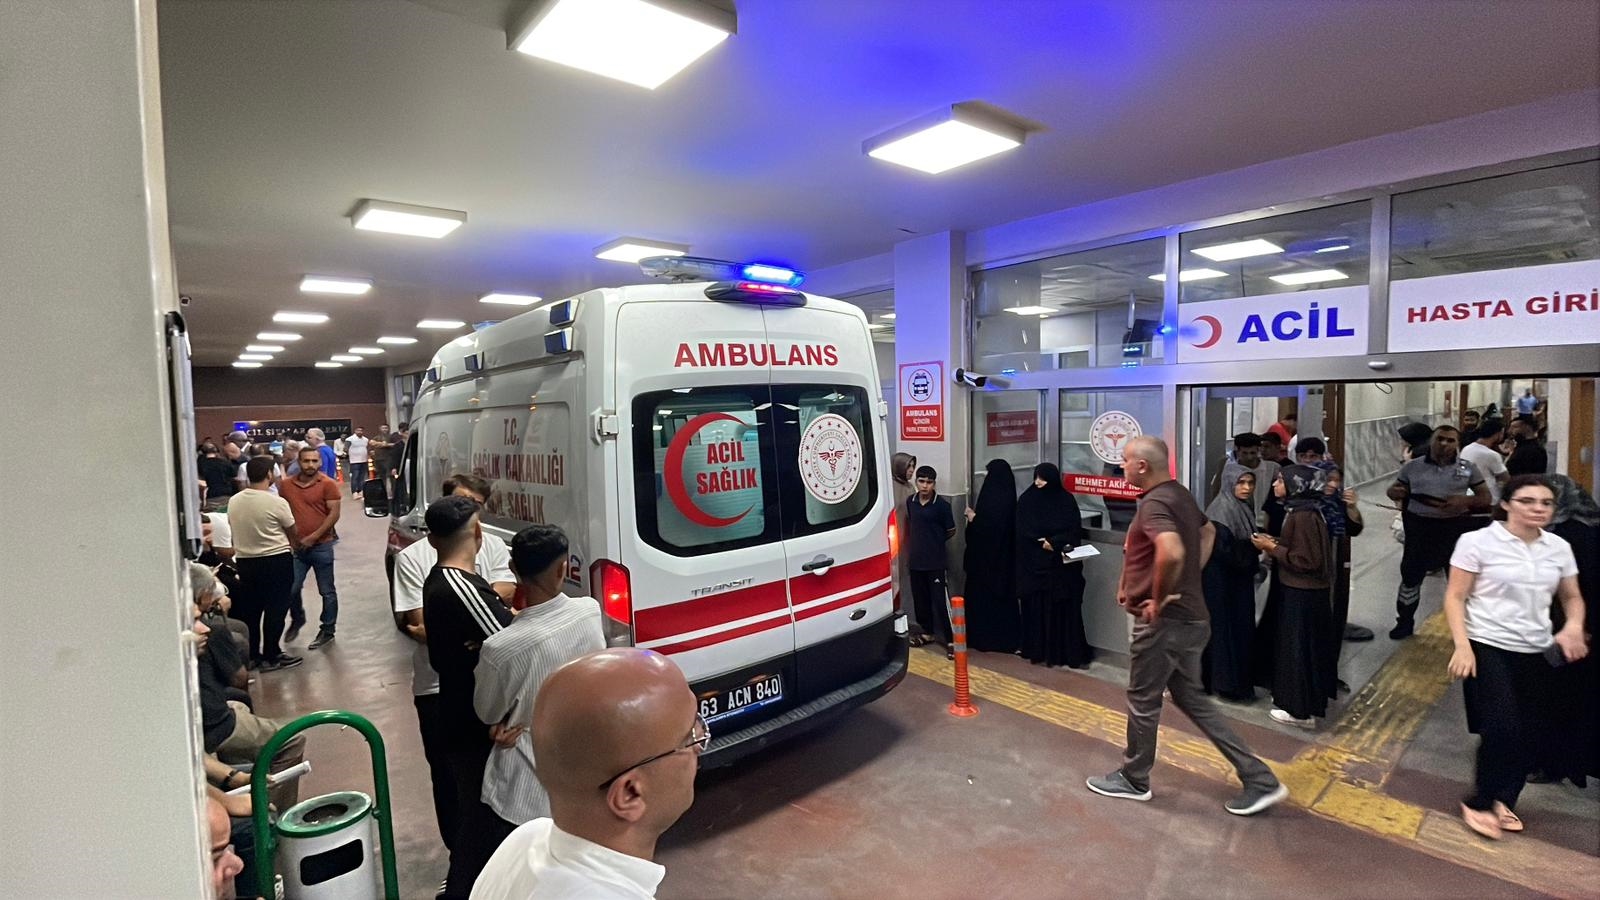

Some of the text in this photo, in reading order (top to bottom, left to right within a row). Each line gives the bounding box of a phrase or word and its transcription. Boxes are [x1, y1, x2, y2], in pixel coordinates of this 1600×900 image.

[1237, 302, 1355, 343] ACİL
[1407, 299, 1514, 323] HASTA
[674, 342, 839, 367] AMBULANS
[905, 409, 938, 417] AMBULANS
[503, 418, 520, 446] T.C.
[707, 438, 745, 464] ACİL
[505, 447, 564, 486] BAKANLIĞI
[696, 466, 758, 494] SAĞLIK
[1074, 477, 1107, 488] MEHMET
[1109, 479, 1127, 490] AKİF
[508, 489, 545, 525] SAĞLIK
[690, 576, 754, 597] TRANSIT
[701, 697, 718, 718] 63
[728, 686, 752, 710] ACN
[756, 678, 779, 700] 840
